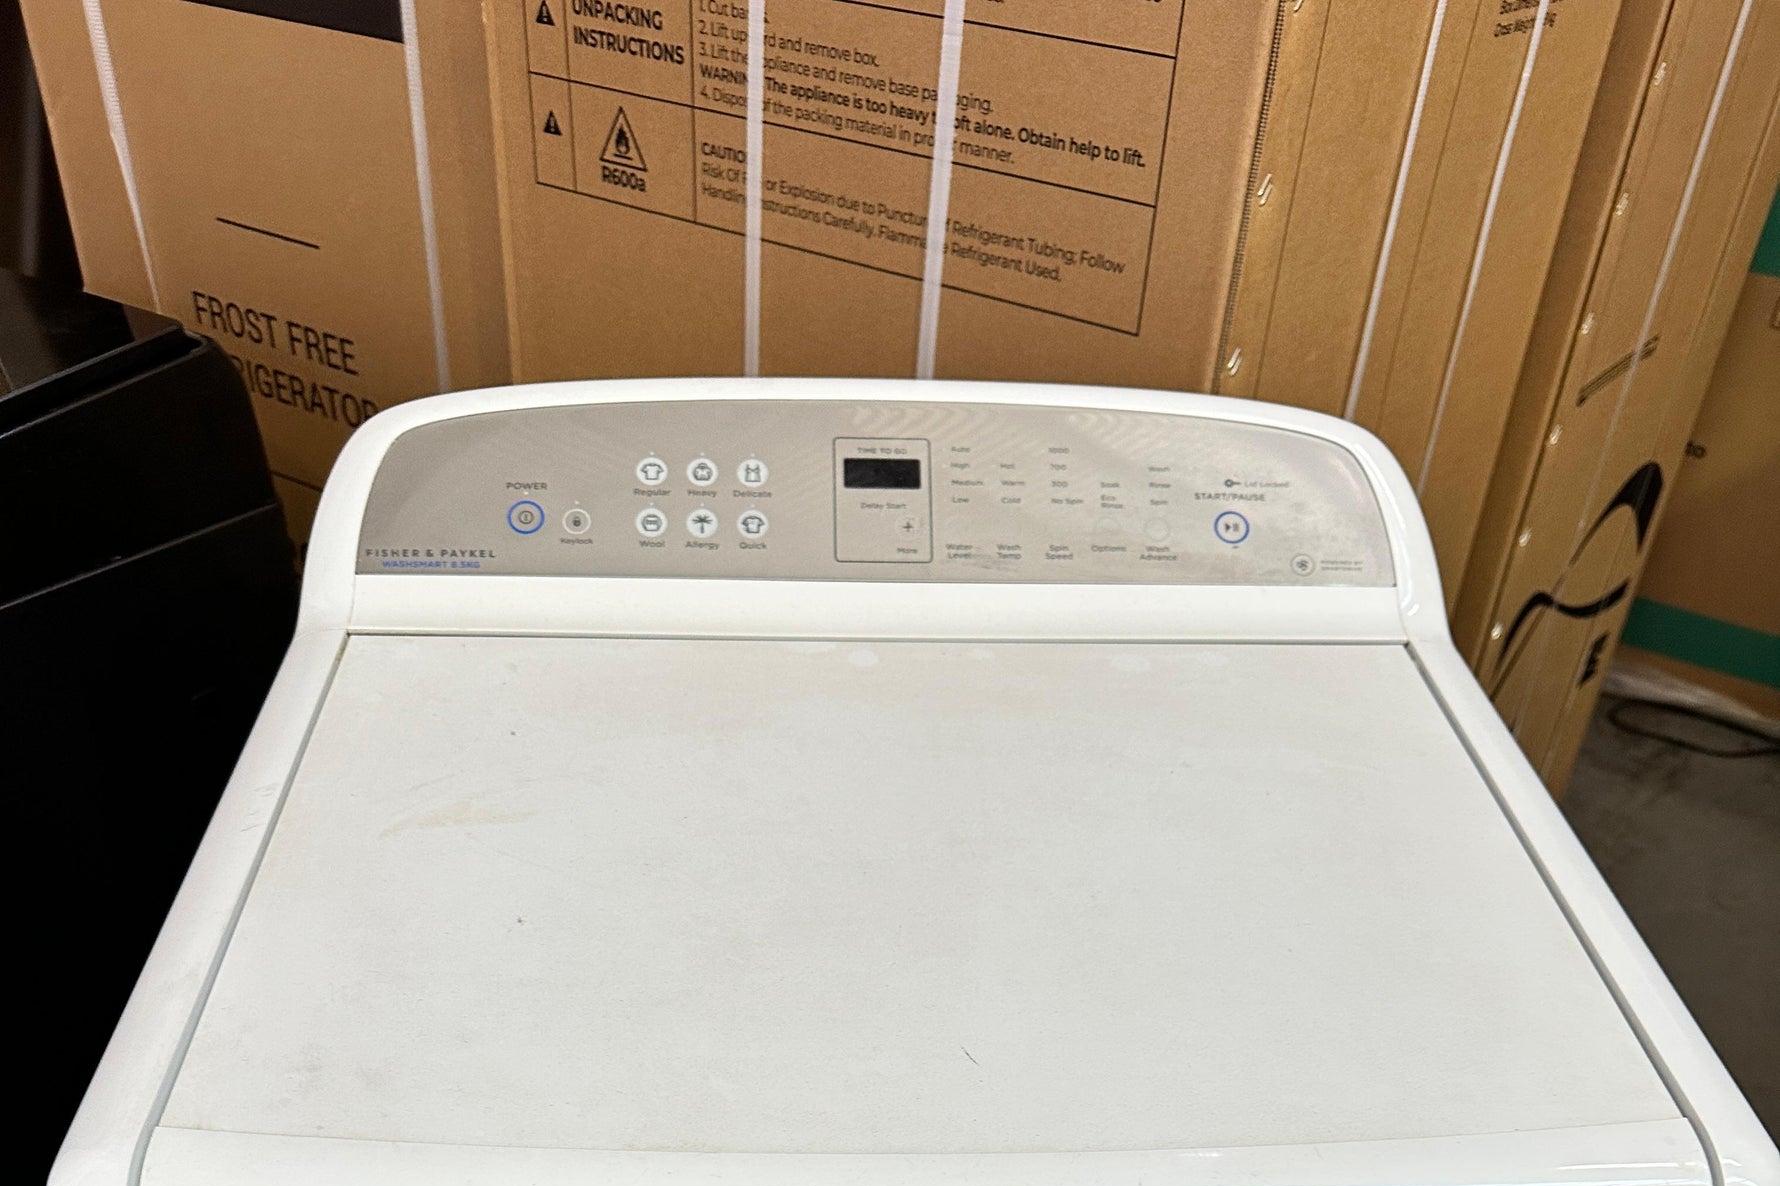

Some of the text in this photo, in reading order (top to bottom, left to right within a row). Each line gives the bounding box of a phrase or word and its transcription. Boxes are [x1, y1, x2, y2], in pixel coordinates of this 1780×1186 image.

[573, 0, 663, 30] UNPACKING
[573, 25, 685, 65] INSTRUCTIONS
[710, 22, 729, 38] Lift
[732, 29, 776, 48] uprd
[779, 37, 802, 53] and
[804, 41, 852, 61] remove
[854, 47, 880, 67] box.
[711, 44, 729, 60] Lift
[812, 63, 836, 82] and
[839, 69, 886, 91] remove
[889, 78, 919, 97] base
[922, 86, 995, 115] paging.
[764, 76, 1146, 168] The appliance is too heavy alone. Obtain help to lift.
[773, 102, 793, 117] the
[795, 106, 843, 130] packing
[845, 118, 896, 139] material
[900, 125, 911, 140] in
[960, 141, 1015, 164] manner.
[601, 164, 647, 193] R600a
[702, 162, 726, 179] Risk
[780, 180, 835, 204] Explosion
[862, 201, 877, 214] to
[953, 221, 1025, 251] Refrigerant
[1079, 250, 1126, 274] Follow
[951, 243, 1023, 273] Refrigerant
[1025, 261, 1062, 282] Used.
[191, 290, 361, 377] FROST FREE
[506, 482, 548, 490] POWER
[633, 488, 672, 498] Regular
[687, 489, 717, 498] Heavy
[732, 489, 773, 498] Delicate
[1194, 492, 1266, 502] START/PAUSE
[365, 549, 497, 558] FISHER & PAYKEL
[639, 540, 666, 548] Wool
[685, 541, 719, 551] Allergy
[739, 541, 768, 550] Quick
[382, 560, 447, 568] WASHSMART
